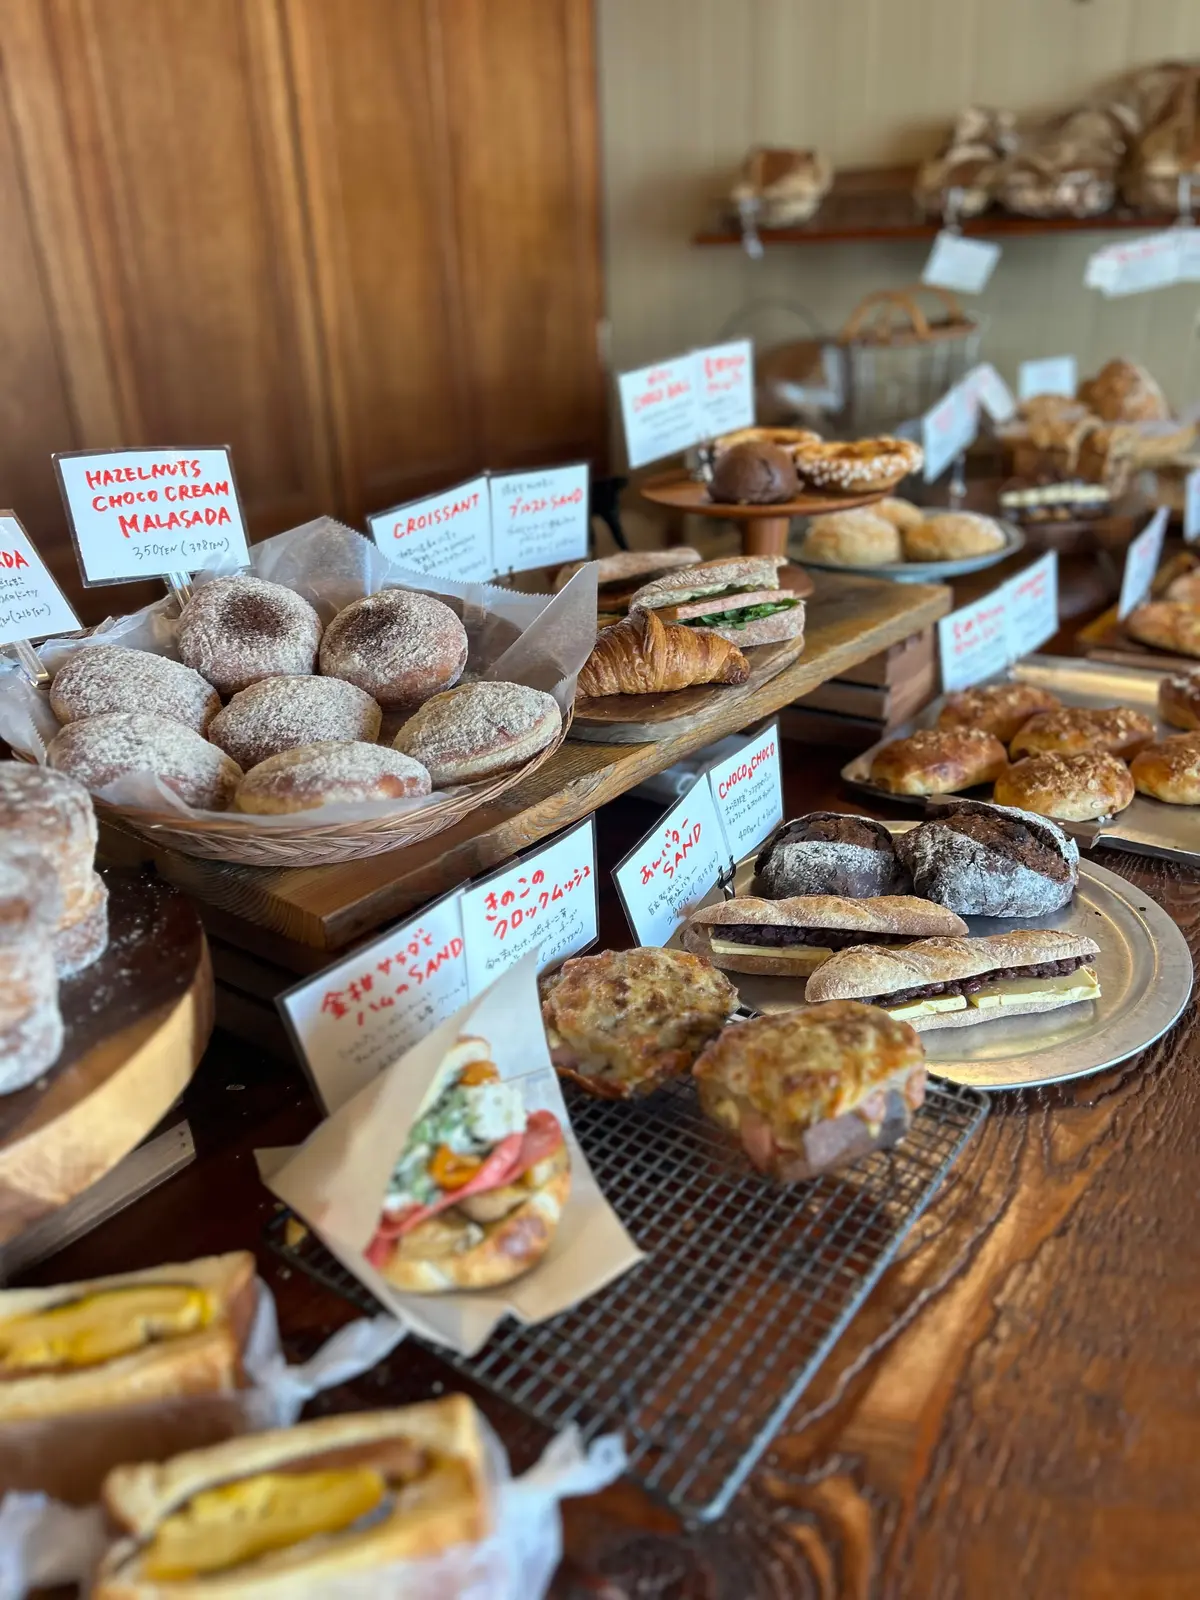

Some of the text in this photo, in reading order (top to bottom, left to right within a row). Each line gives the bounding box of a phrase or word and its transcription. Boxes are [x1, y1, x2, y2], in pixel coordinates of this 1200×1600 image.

[85, 459, 202, 490] HAZELNUTS
[92, 481, 229, 512] CHOCO CREAM
[118, 506, 232, 539] MALASADA
[393, 492, 479, 539] CROISSANT
[640, 818, 688, 885] あんバター
[663, 823, 701, 879] SAND
[484, 869, 545, 921] きのこの
[493, 866, 591, 940] クロックムッシュ
